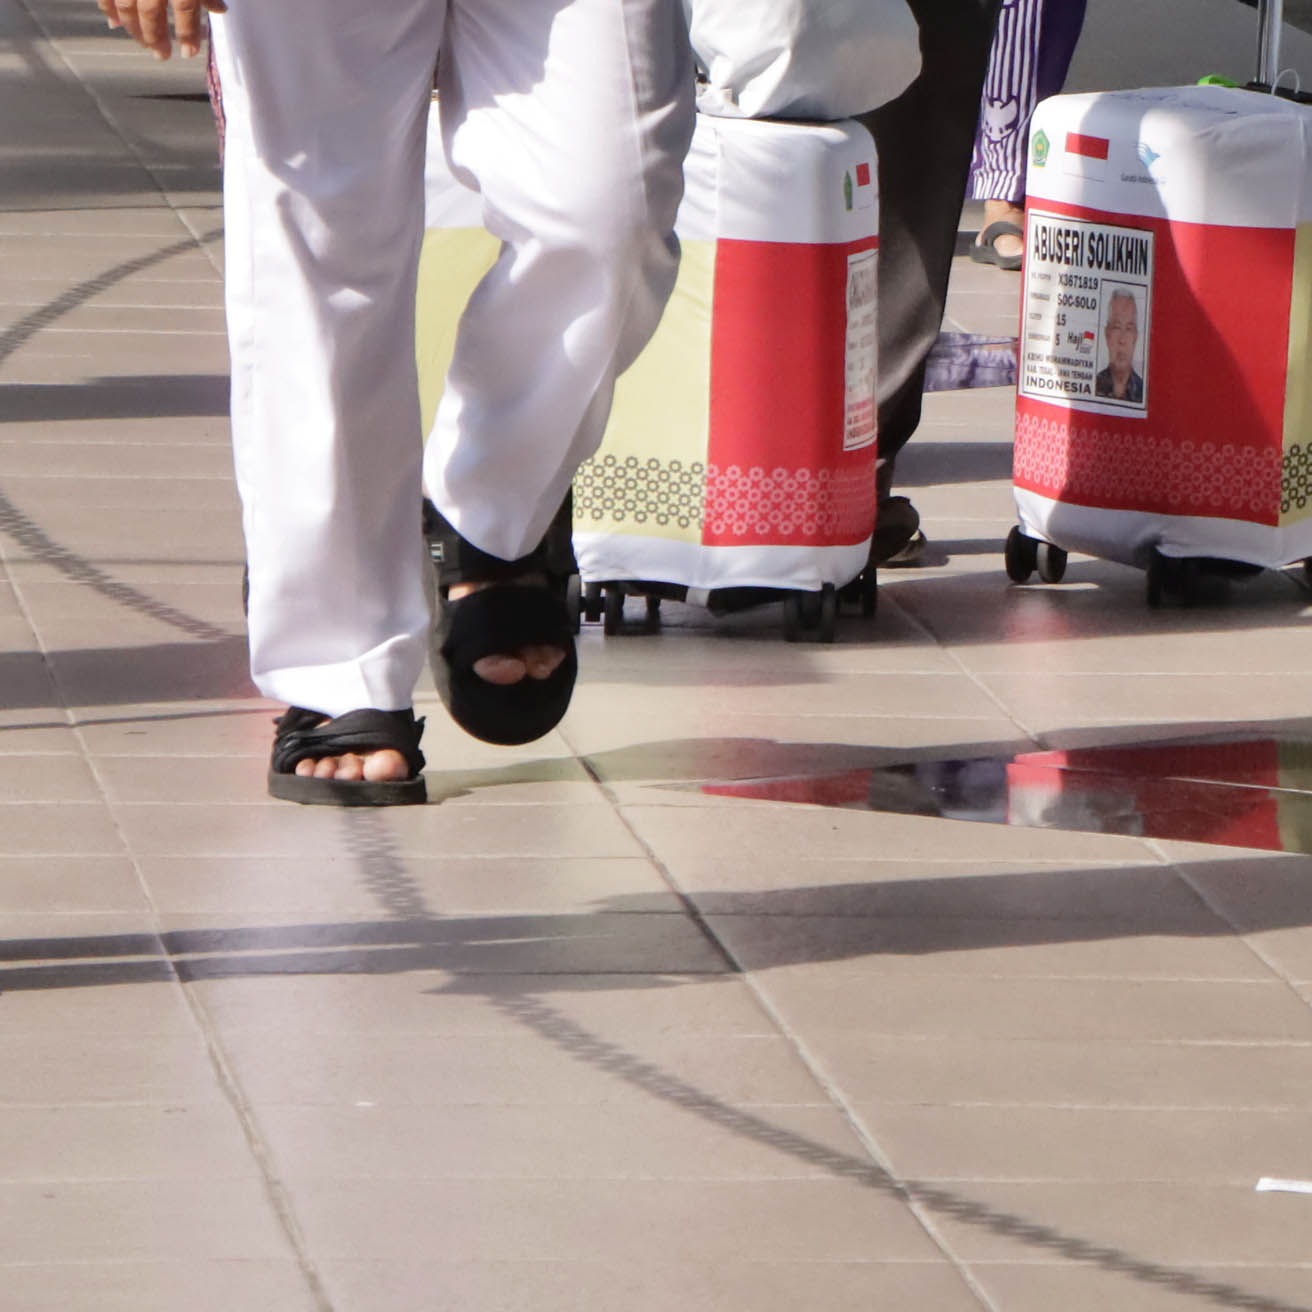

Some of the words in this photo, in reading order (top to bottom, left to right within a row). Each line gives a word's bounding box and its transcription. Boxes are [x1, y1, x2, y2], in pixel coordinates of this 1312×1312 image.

[1033, 224, 1085, 268] ABUSERI
[1087, 231, 1149, 276] SOLIKHIN
[1058, 273, 1099, 290] X3671819
[1058, 293, 1097, 310] SOC-SOLO
[1056, 313, 1067, 326] 15
[1026, 376, 1092, 395] INDONESIA
